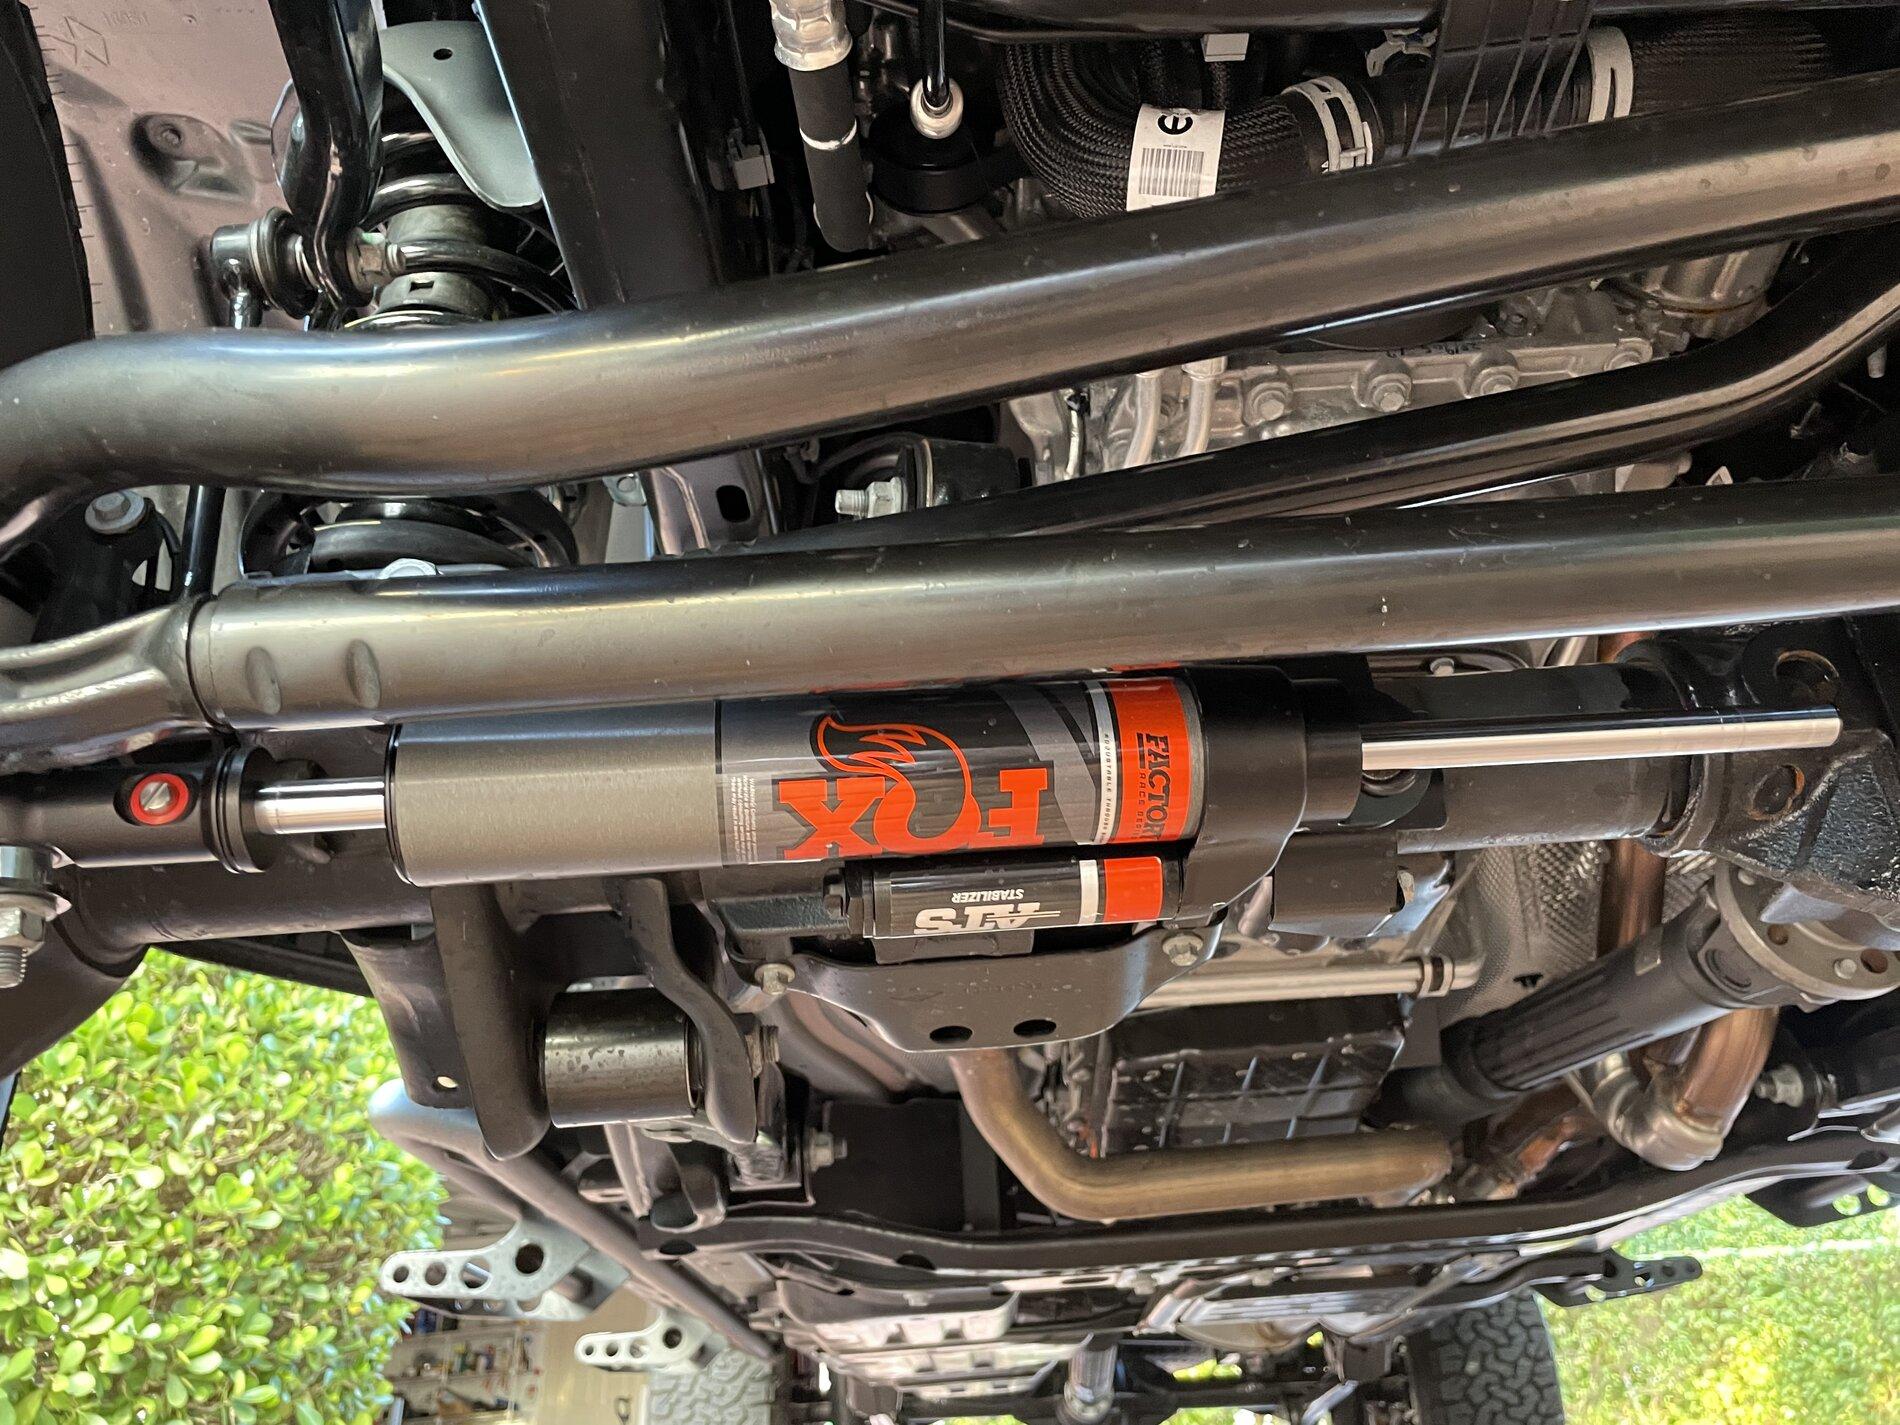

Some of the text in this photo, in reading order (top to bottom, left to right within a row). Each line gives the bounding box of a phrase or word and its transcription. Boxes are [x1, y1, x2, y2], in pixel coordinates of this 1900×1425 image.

[778, 716, 1049, 860] FOX
[951, 888, 1025, 904] STABILIZER
[914, 902, 1061, 935] ATS
